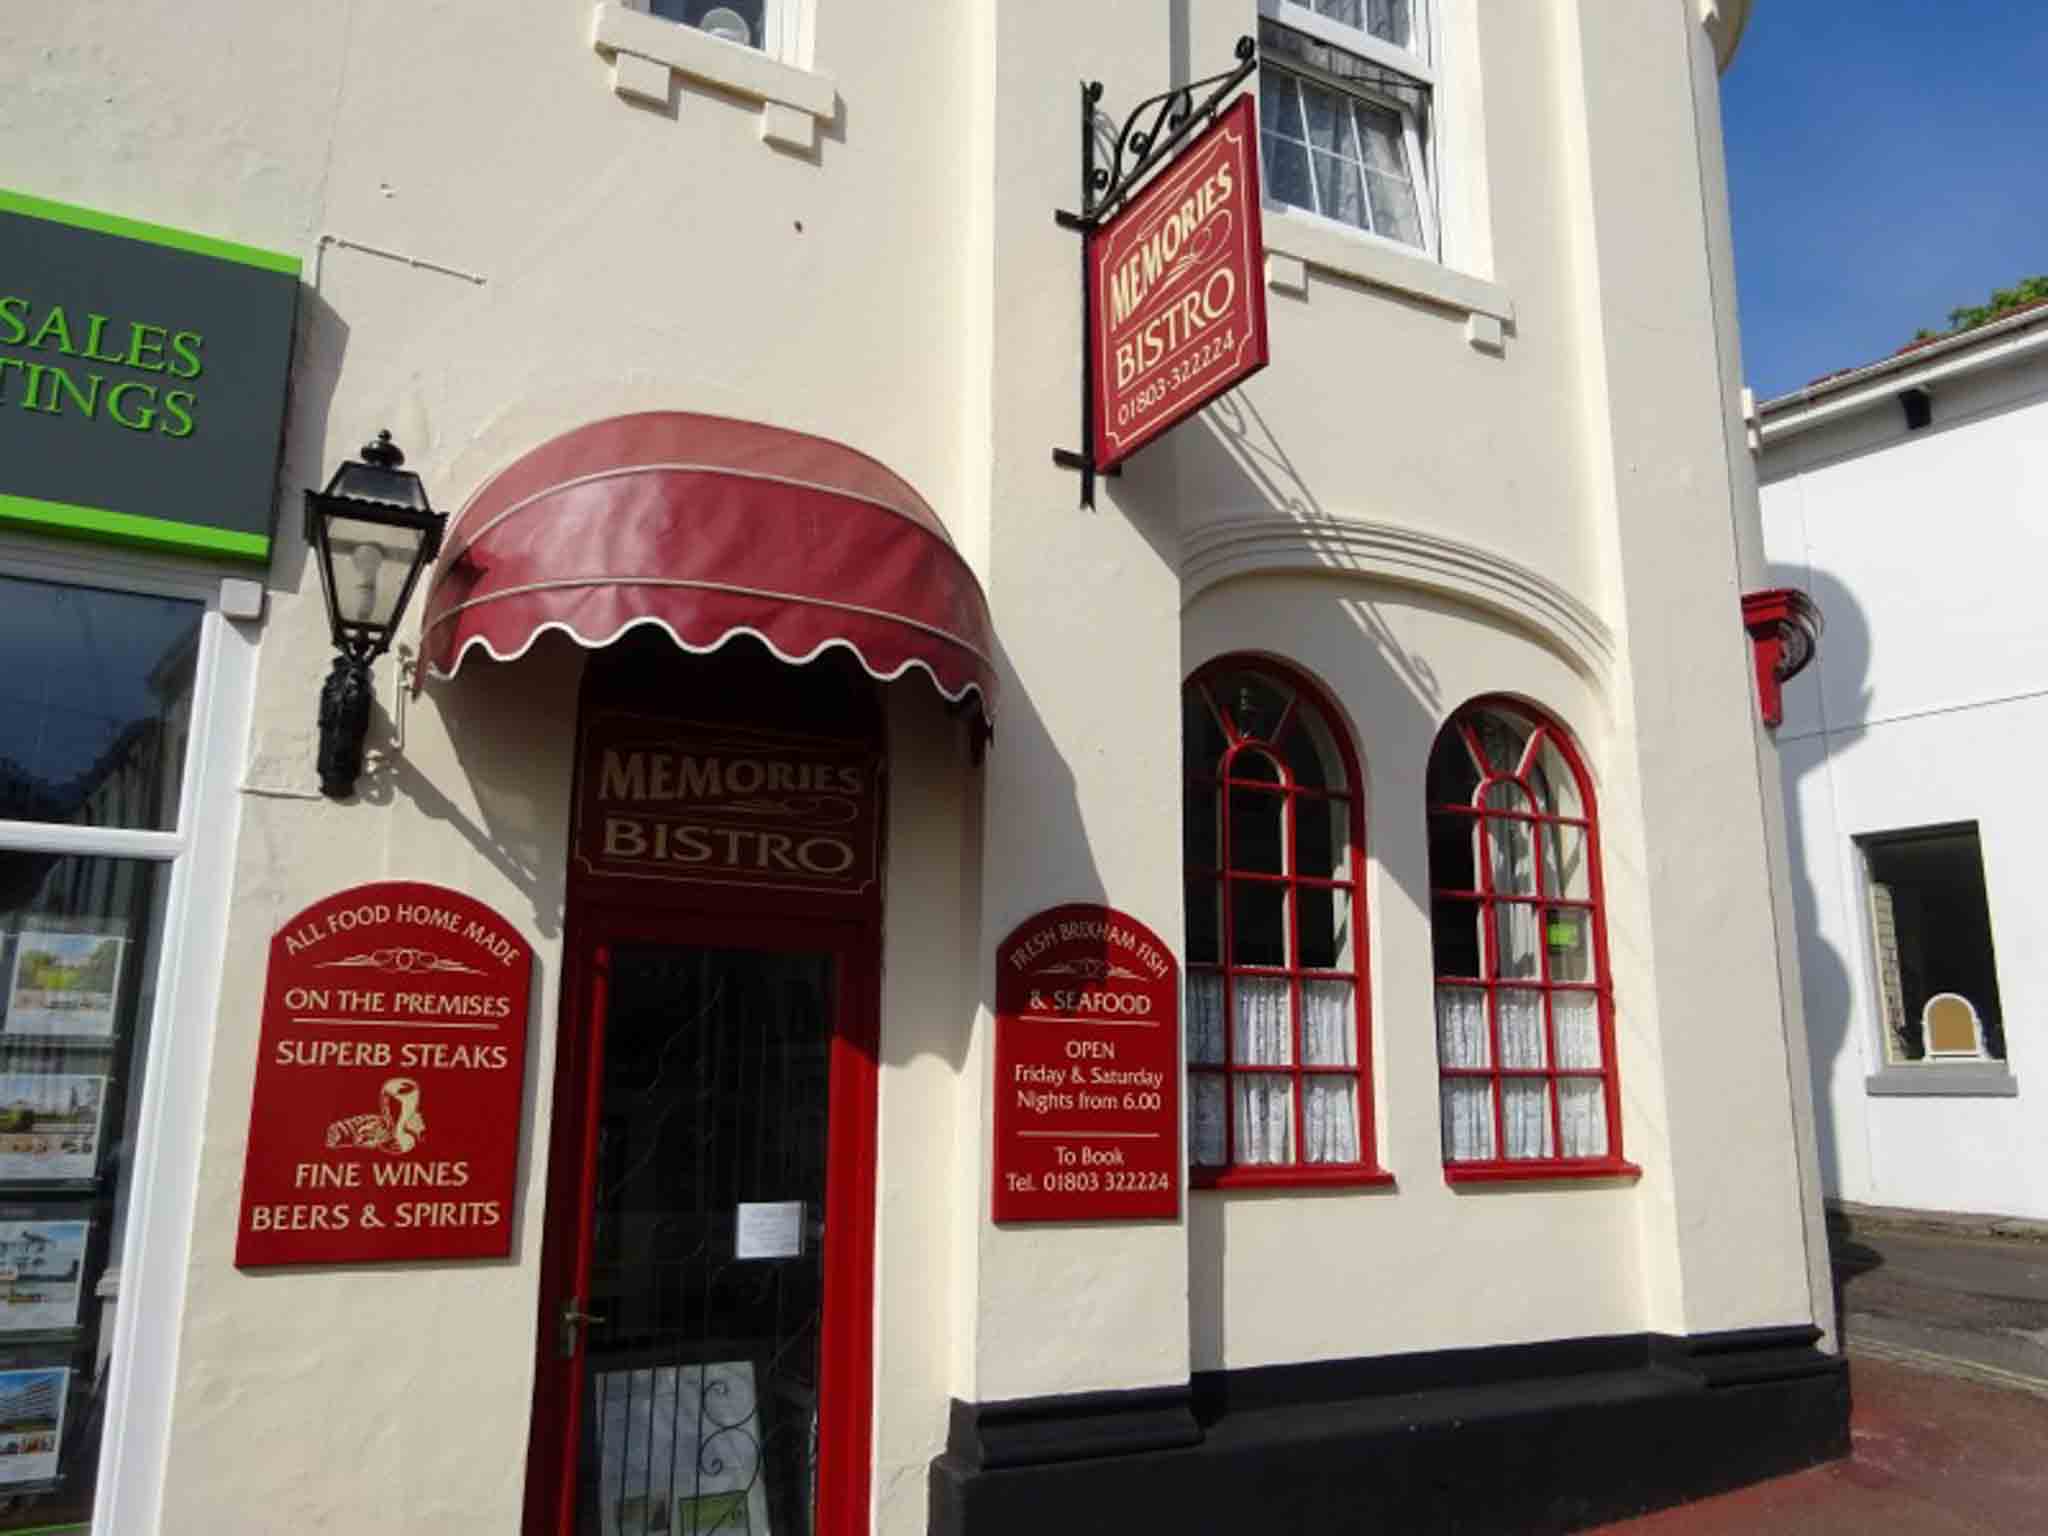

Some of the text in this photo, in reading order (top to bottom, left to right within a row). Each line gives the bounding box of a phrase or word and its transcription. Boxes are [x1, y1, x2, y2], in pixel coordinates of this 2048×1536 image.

[1111, 162, 1233, 333] MEMORIES
[0, 296, 204, 378] SALES
[1115, 266, 1236, 391] BISTRO
[598, 750, 864, 801] MEMORIES
[602, 817, 855, 873] BISTRO
[284, 903, 521, 967] ALL FOOD HOME MADE
[1009, 928, 1058, 971] FRESH
[1135, 943, 1169, 979] FISH
[284, 987, 511, 1017] ON THE PREMISES
[1028, 988, 1152, 1015] & SEAFOOD
[275, 1039, 509, 1069] SUPERB STEAKS
[1064, 1040, 1116, 1059] OPEN
[1014, 1064, 1164, 1090] Friday & Saturday
[1016, 1090, 1161, 1115] Nights from 6.00
[1054, 1146, 1125, 1166] To Book
[294, 1161, 470, 1188] FINE WINES
[1042, 1171, 1100, 1192] 01803
[1104, 1171, 1170, 1192] 322224
[251, 1200, 502, 1232] BEERS & SPIRITS
